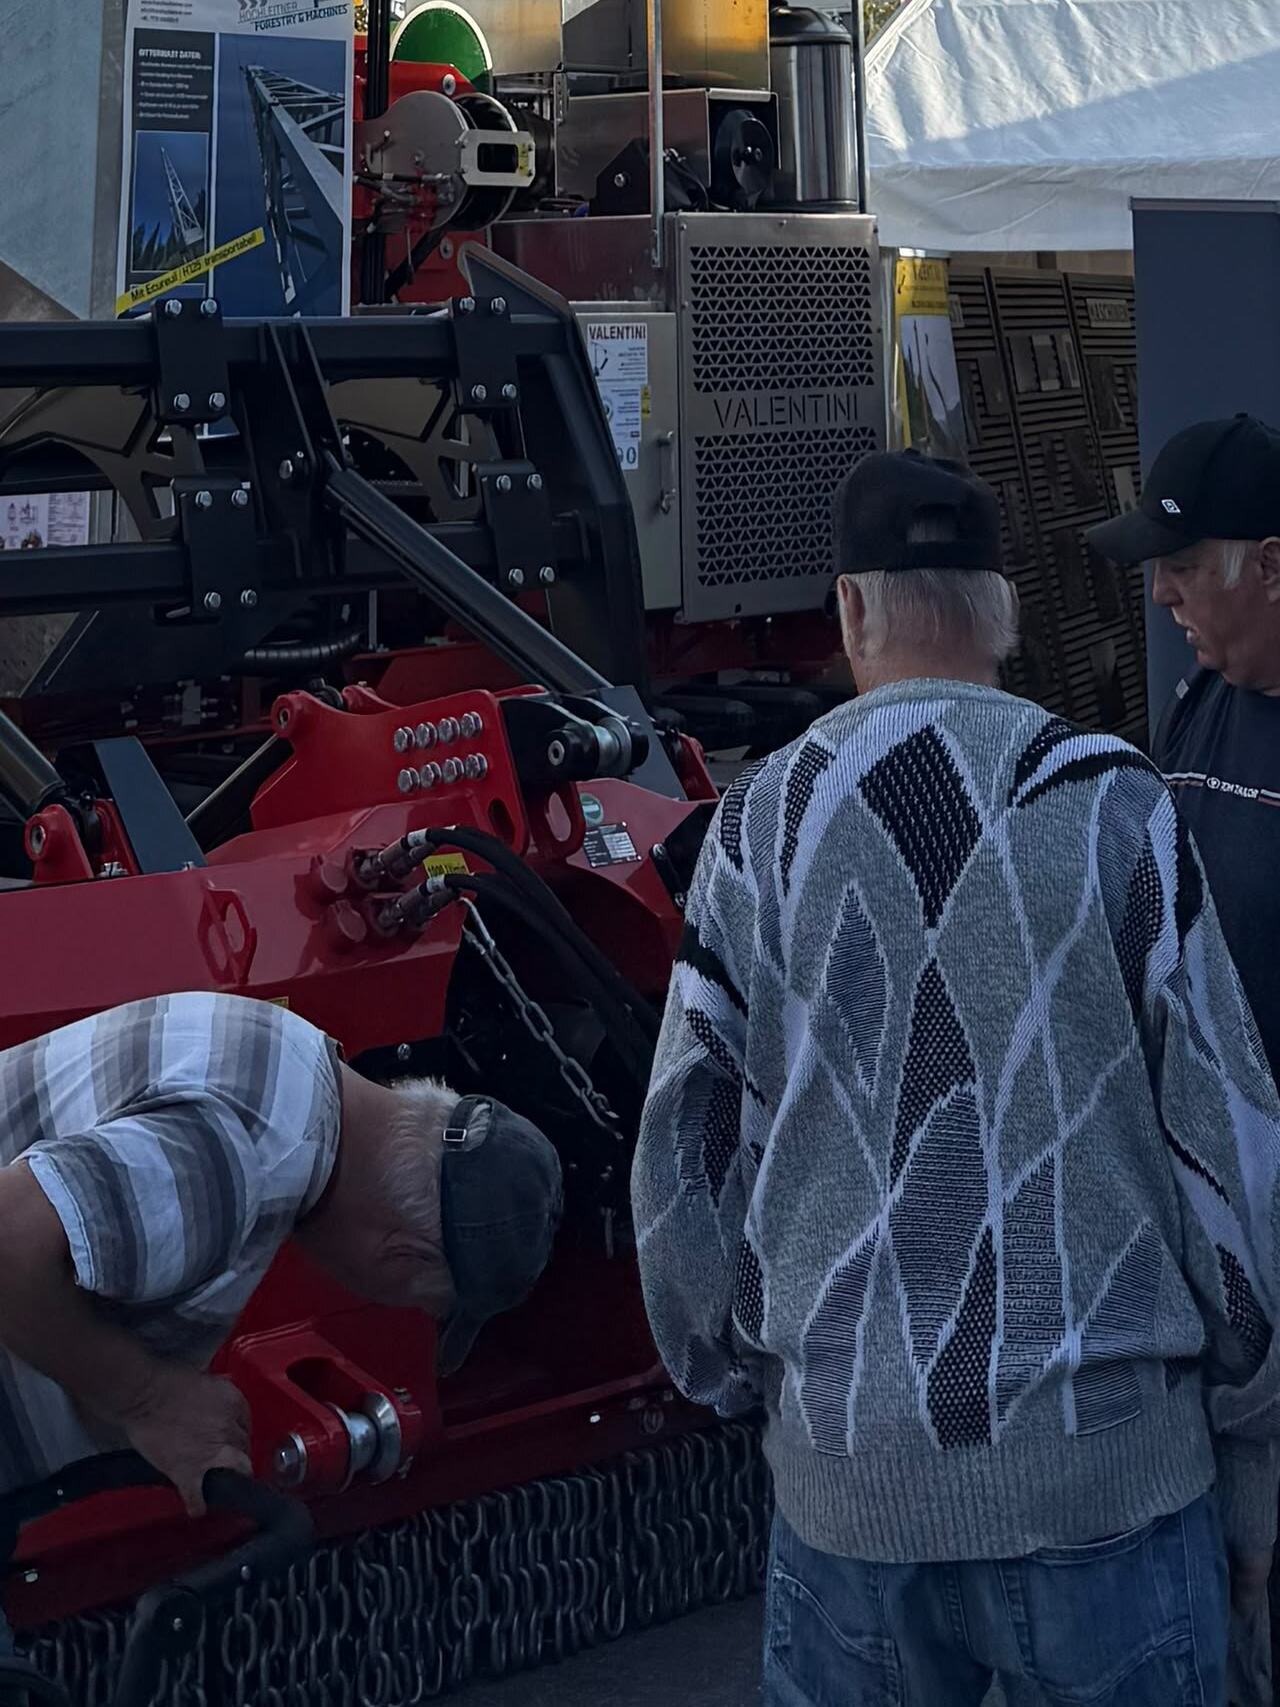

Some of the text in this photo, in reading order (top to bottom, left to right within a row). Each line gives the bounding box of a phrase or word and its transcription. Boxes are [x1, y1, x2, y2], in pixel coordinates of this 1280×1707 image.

[238, 1, 298, 21] HOCHLEITNER
[254, 13, 298, 32] FORESTRY
[305, 3, 349, 23] MACHINES
[589, 325, 647, 340] VALENTINI
[713, 392, 859, 429] VALENTINI
